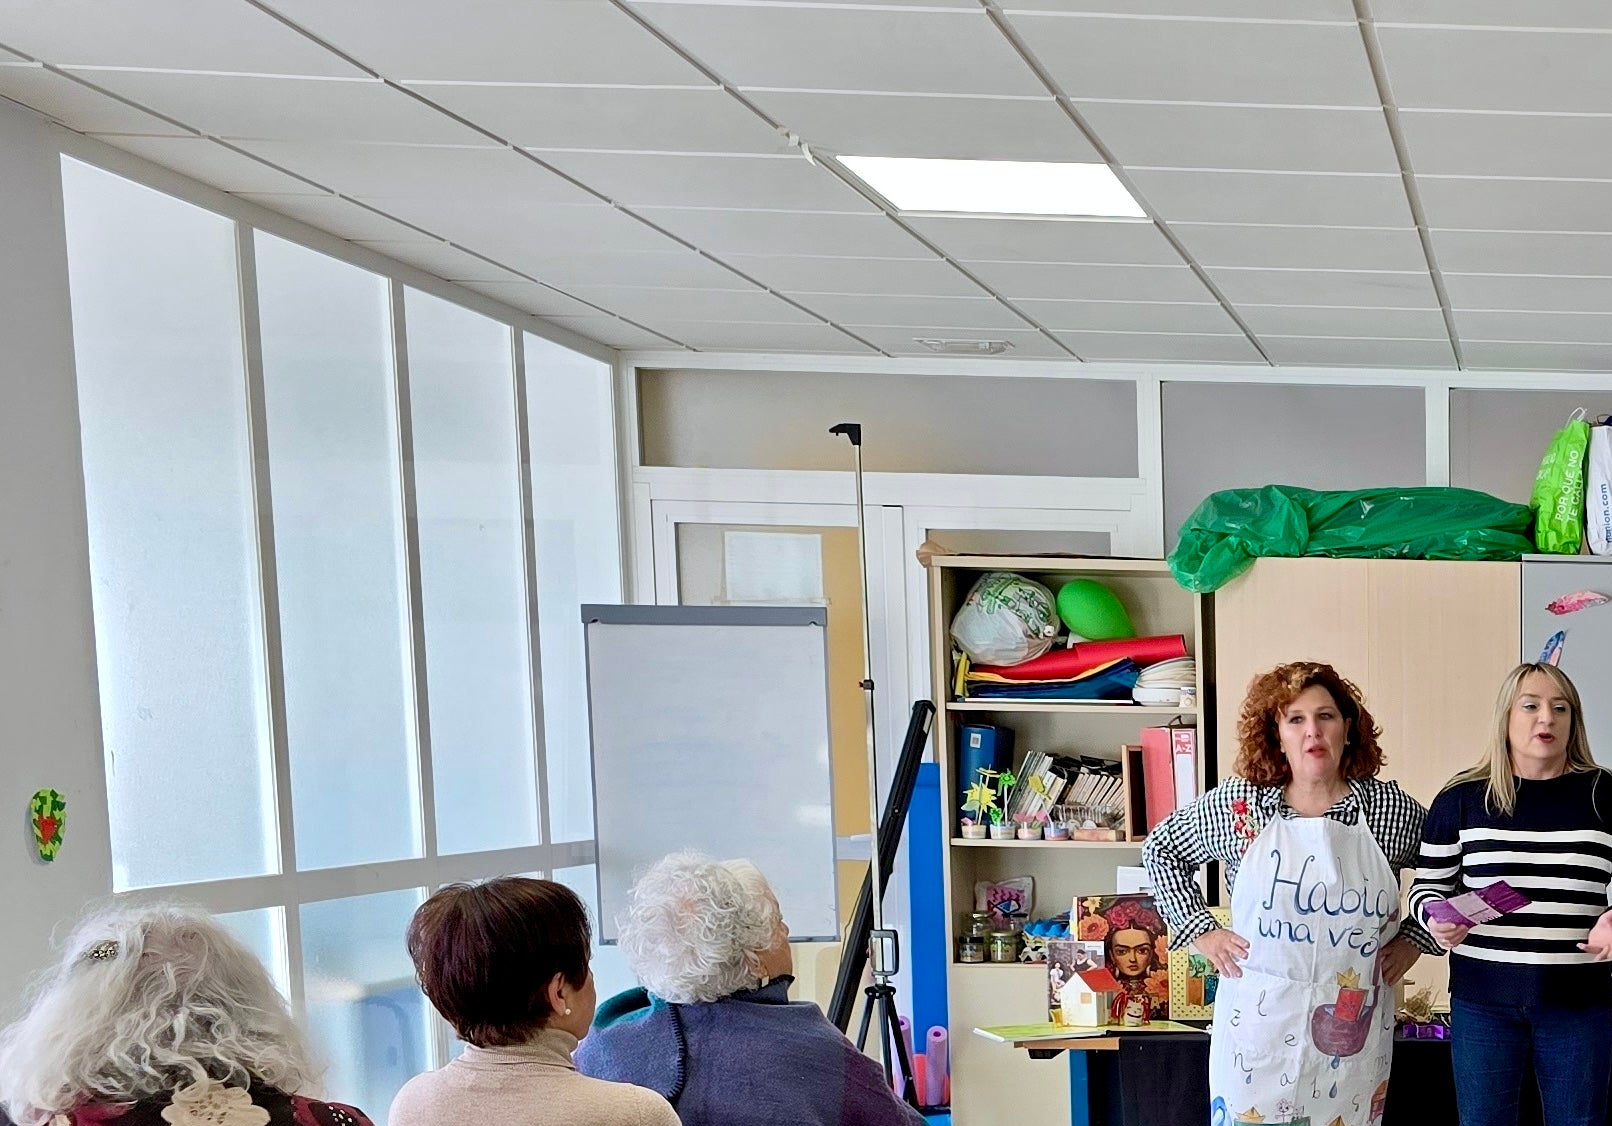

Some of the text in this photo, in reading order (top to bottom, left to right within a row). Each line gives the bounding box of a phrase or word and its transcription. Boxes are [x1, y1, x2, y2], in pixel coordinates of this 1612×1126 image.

[1555, 495, 1568, 521] POR
[1568, 450, 1579, 468] NO
[1567, 507, 1579, 522] TE
[1176, 743, 1192, 752] A-Z
[1258, 916, 1379, 957] una vez
[1229, 1008, 1242, 1027] z
[1284, 1033, 1298, 1046] e
[1279, 1072, 1296, 1087] a
[1310, 1075, 1321, 1099] b
